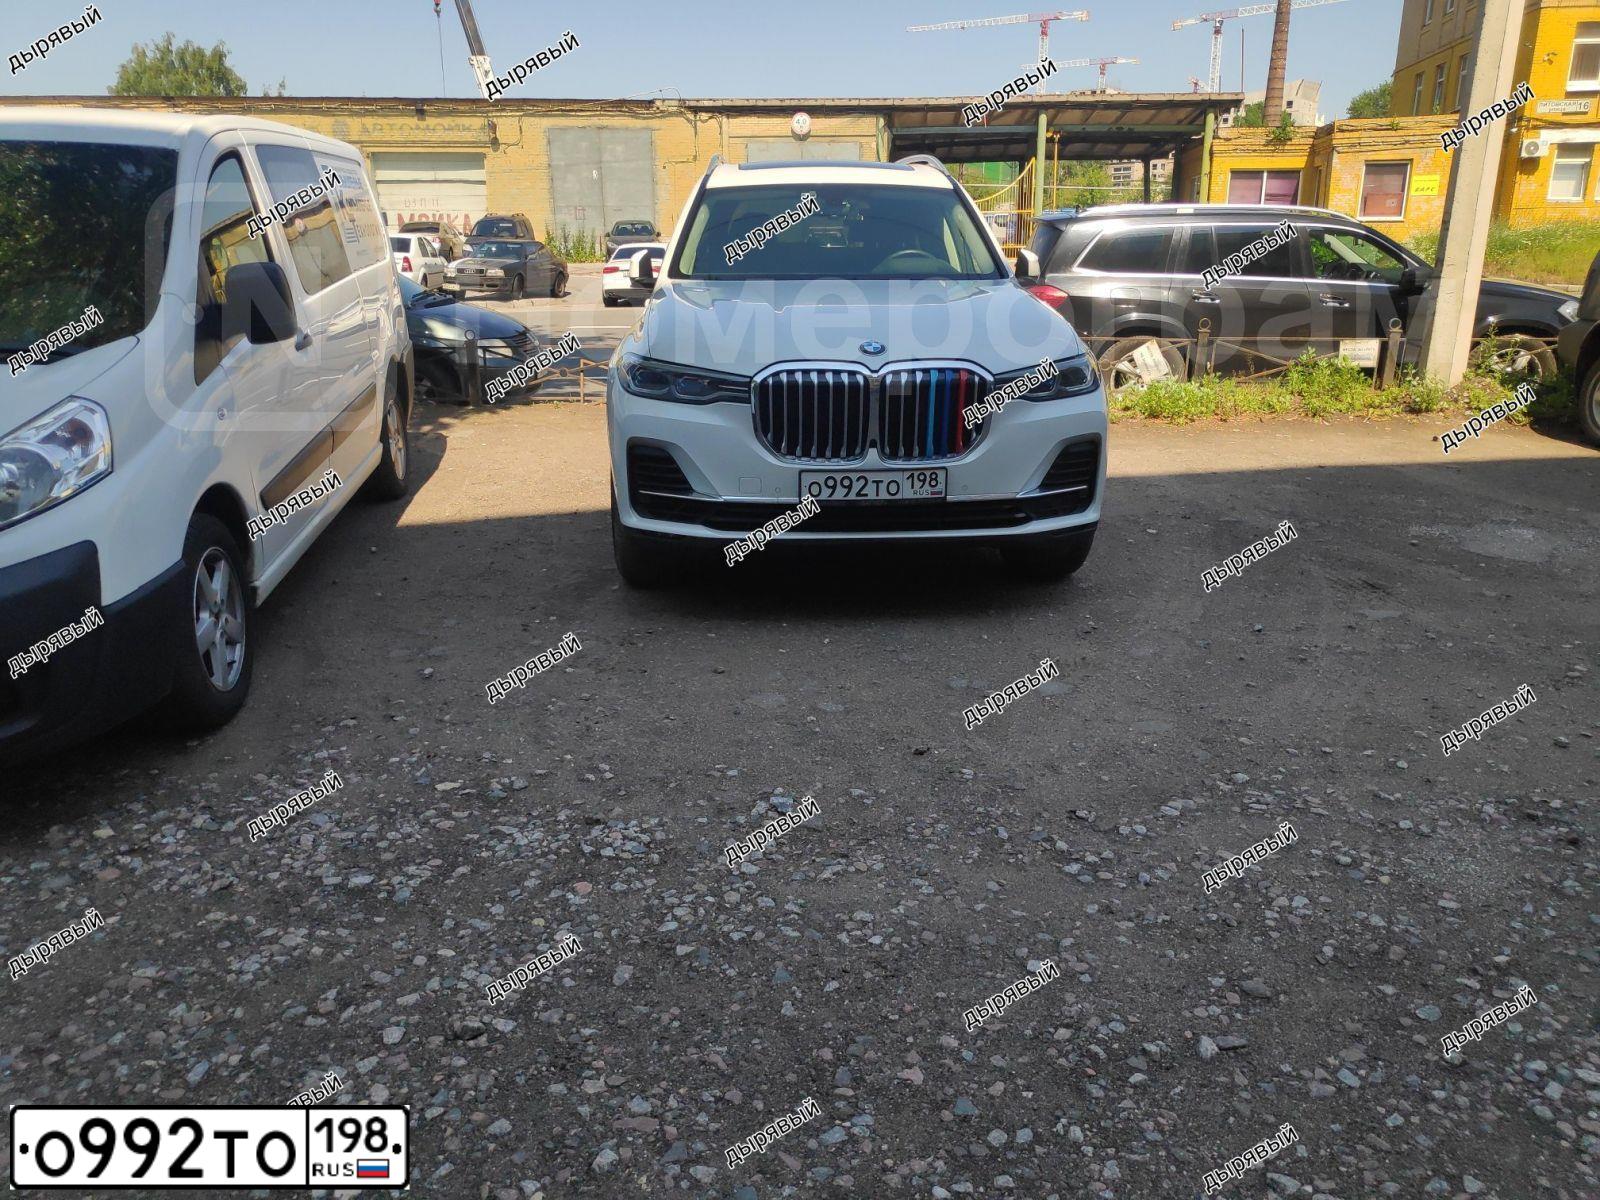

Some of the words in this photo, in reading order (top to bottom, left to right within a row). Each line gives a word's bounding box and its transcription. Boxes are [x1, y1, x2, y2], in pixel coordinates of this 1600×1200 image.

[1578, 101, 1590, 110] 16
[807, 475, 901, 498] О992ТО
[906, 471, 939, 490] 198
